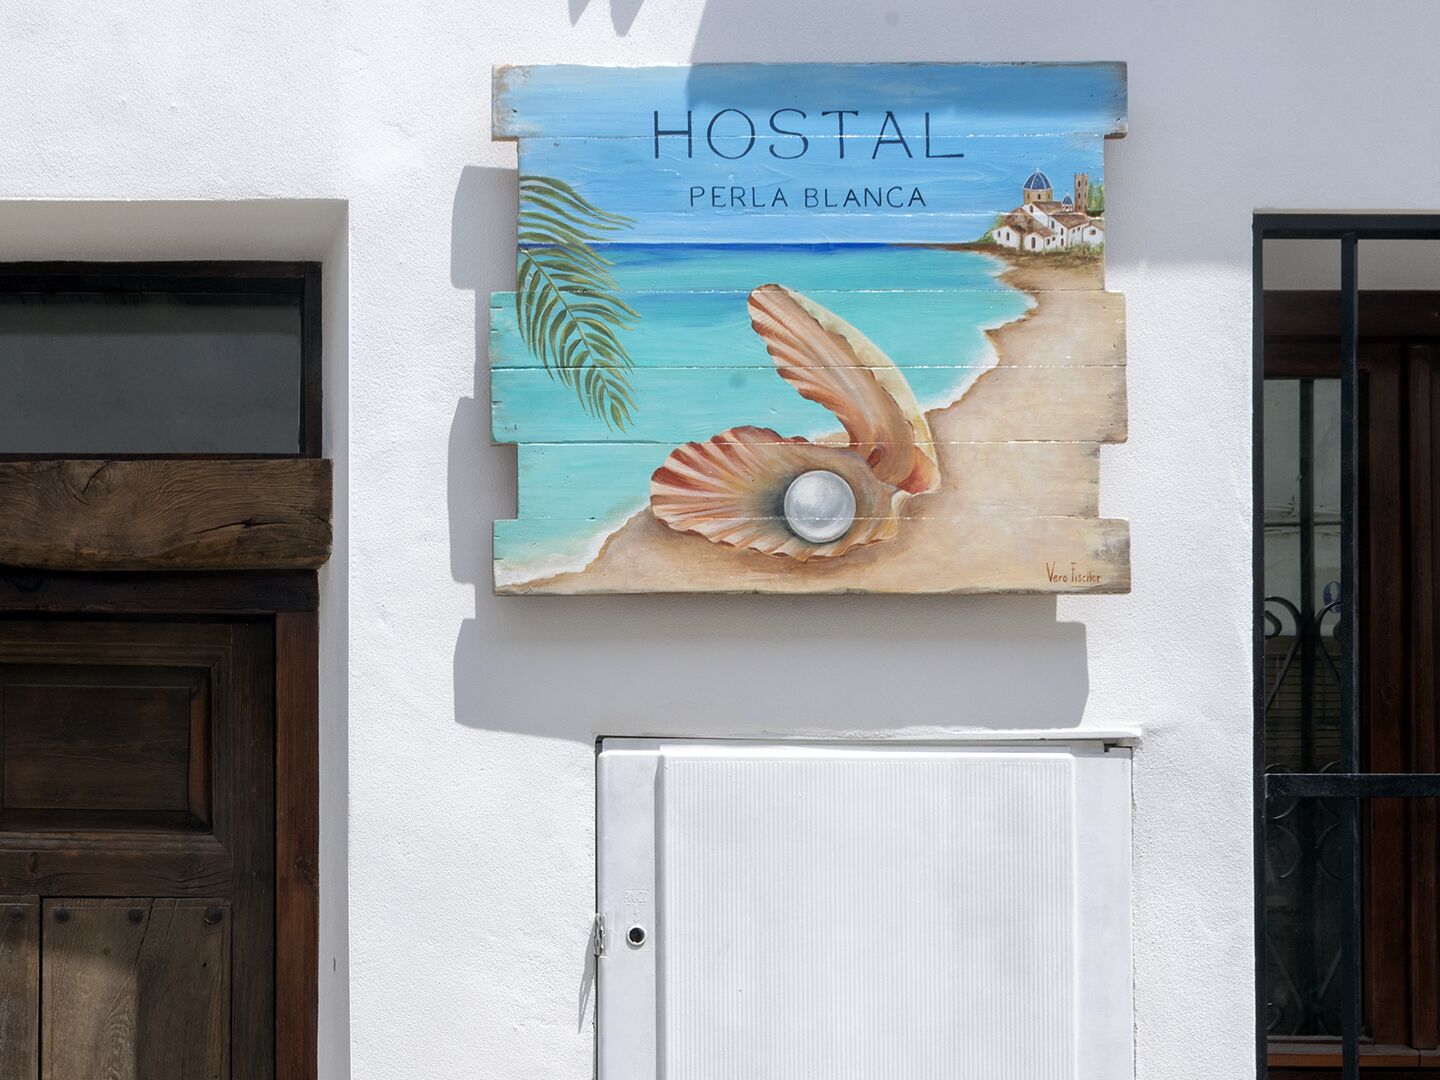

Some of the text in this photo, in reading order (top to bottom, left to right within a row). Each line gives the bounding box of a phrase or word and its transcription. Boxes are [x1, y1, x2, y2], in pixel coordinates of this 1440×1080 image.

[653, 108, 965, 160] HOSTAL
[690, 186, 928, 208] PERLA BLANCA
[1045, 561, 1068, 583] Vero
